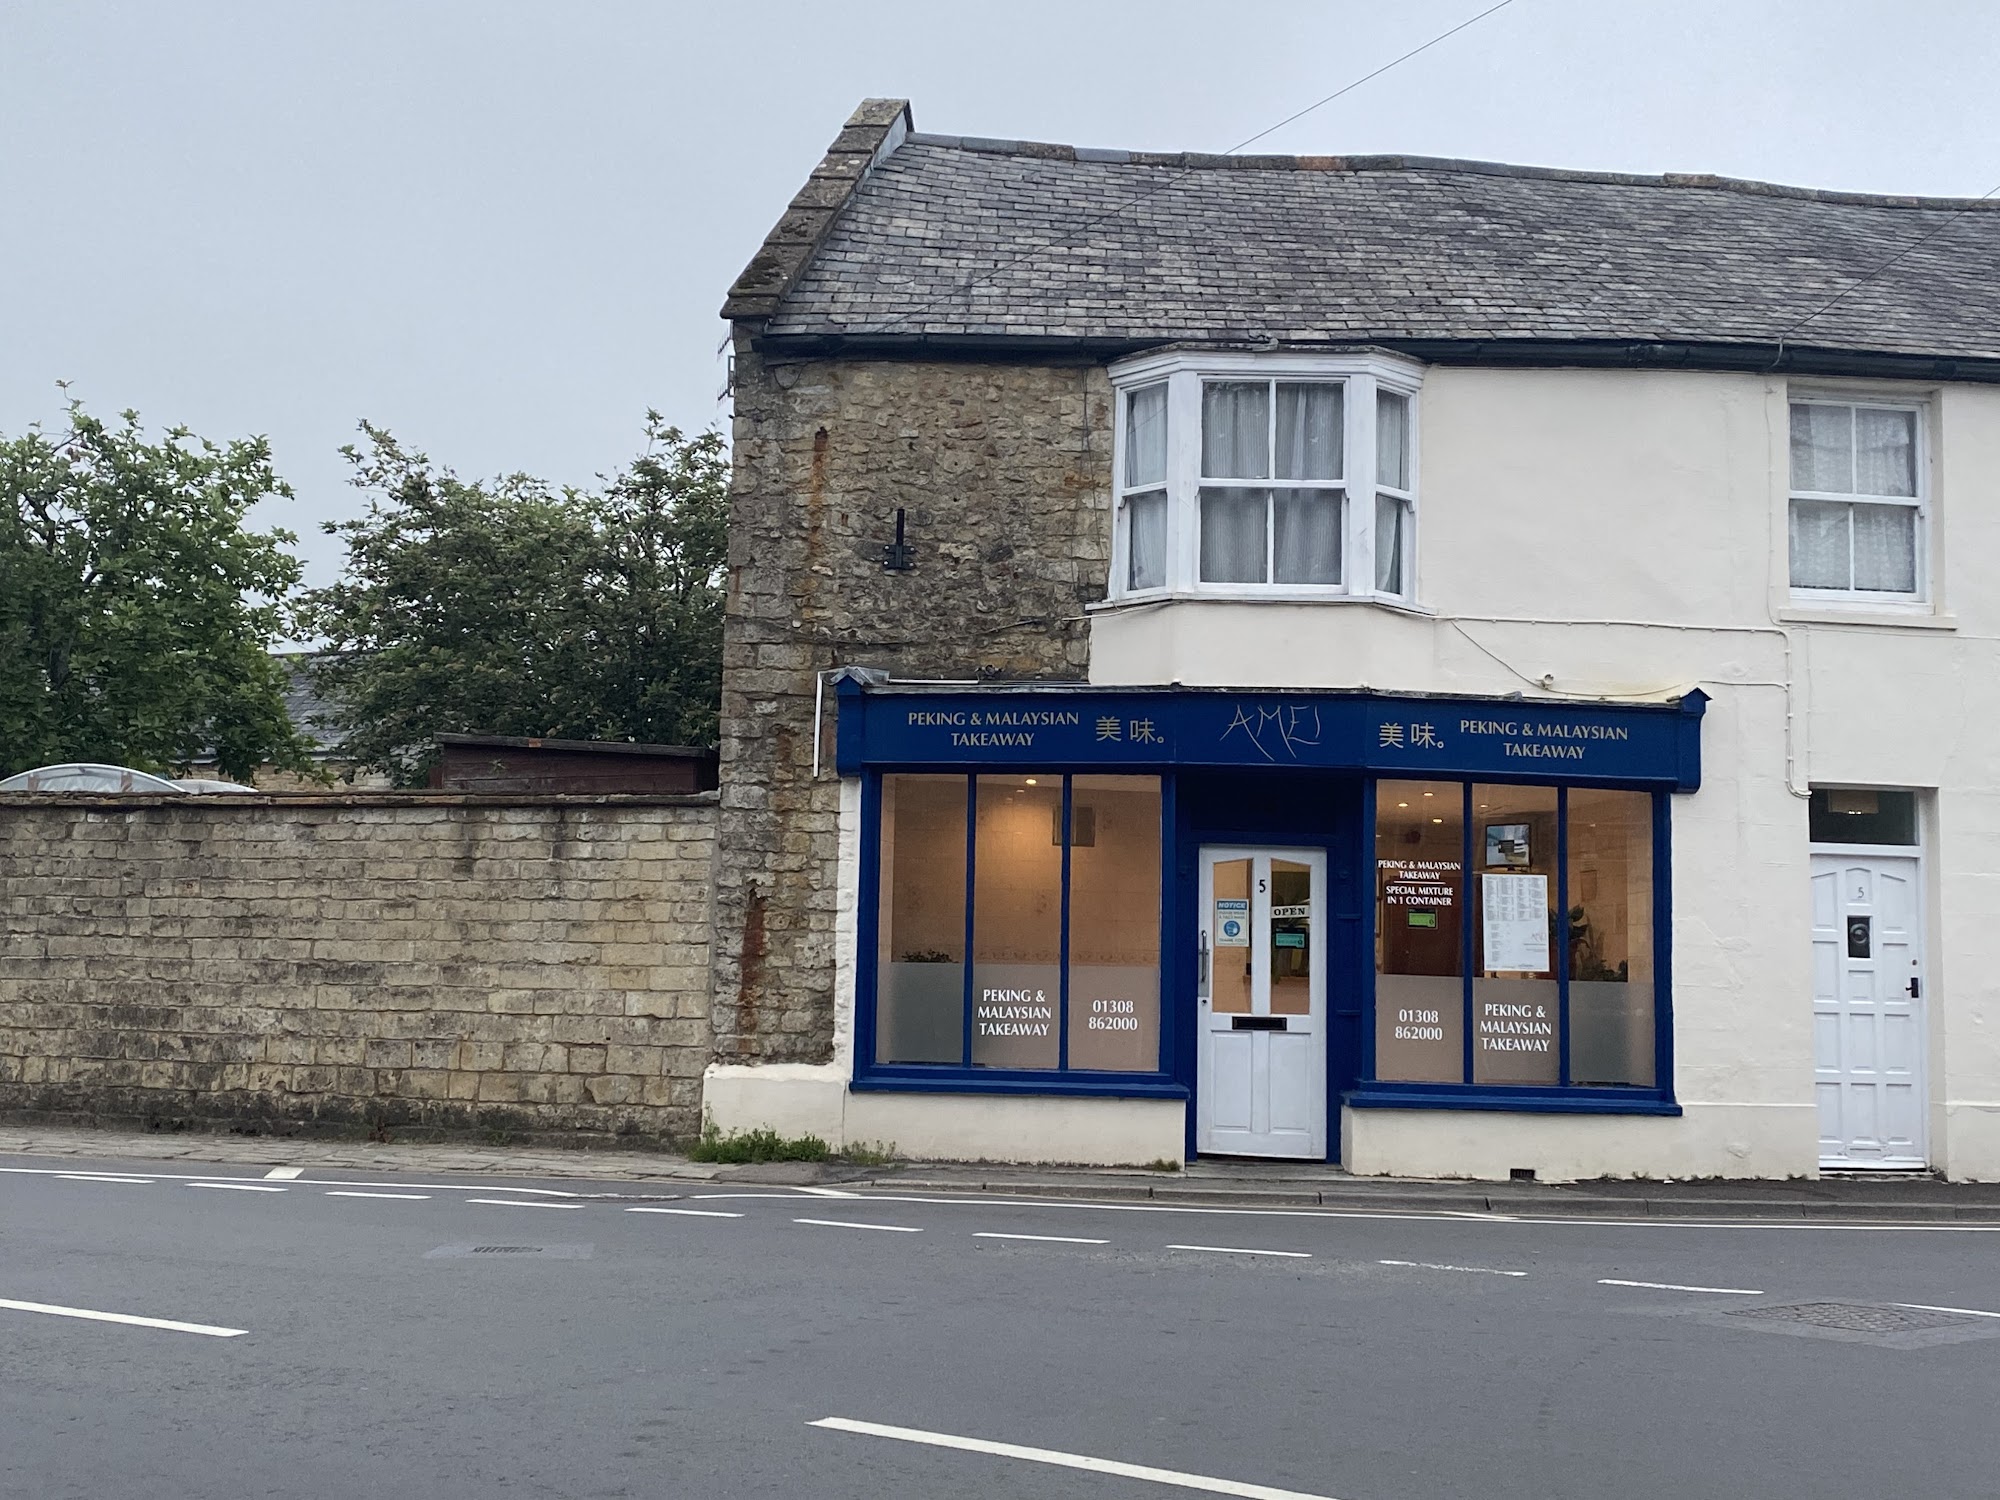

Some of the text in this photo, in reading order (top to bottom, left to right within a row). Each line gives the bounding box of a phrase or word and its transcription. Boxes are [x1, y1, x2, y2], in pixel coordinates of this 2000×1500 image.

[908, 712, 1079, 726] PEKING & MALAYSIAN
[1460, 719, 1629, 741] PEKING & MALAYSIAN
[951, 732, 1035, 747] TAKEAWAY
[1503, 742, 1586, 759] TAKEAWAY
[1378, 859, 1461, 870] PEKING & MALAYSIAN
[1399, 870, 1441, 880] TAKEAWAY
[1258, 879, 1266, 893] 5
[1386, 886, 1454, 896] SPECIAL MIXTURE
[1387, 896, 1397, 905] IN
[1406, 897, 1452, 905] CONTAINER
[1273, 907, 1306, 916] OPEN
[983, 989, 1046, 1002] PEKING &
[977, 1006, 1052, 1019] MALAYSIAN
[1092, 1000, 1134, 1013] 01308
[1484, 1003, 1546, 1018] PEKING &
[1399, 1009, 1439, 1023] 01308
[979, 1022, 1050, 1036] TAKEAWAY
[1088, 1017, 1138, 1031] 862000
[1480, 1020, 1552, 1035] MALAYSIAN
[1395, 1026, 1443, 1041] 862000
[1481, 1037, 1551, 1052] TAKEAWAY
